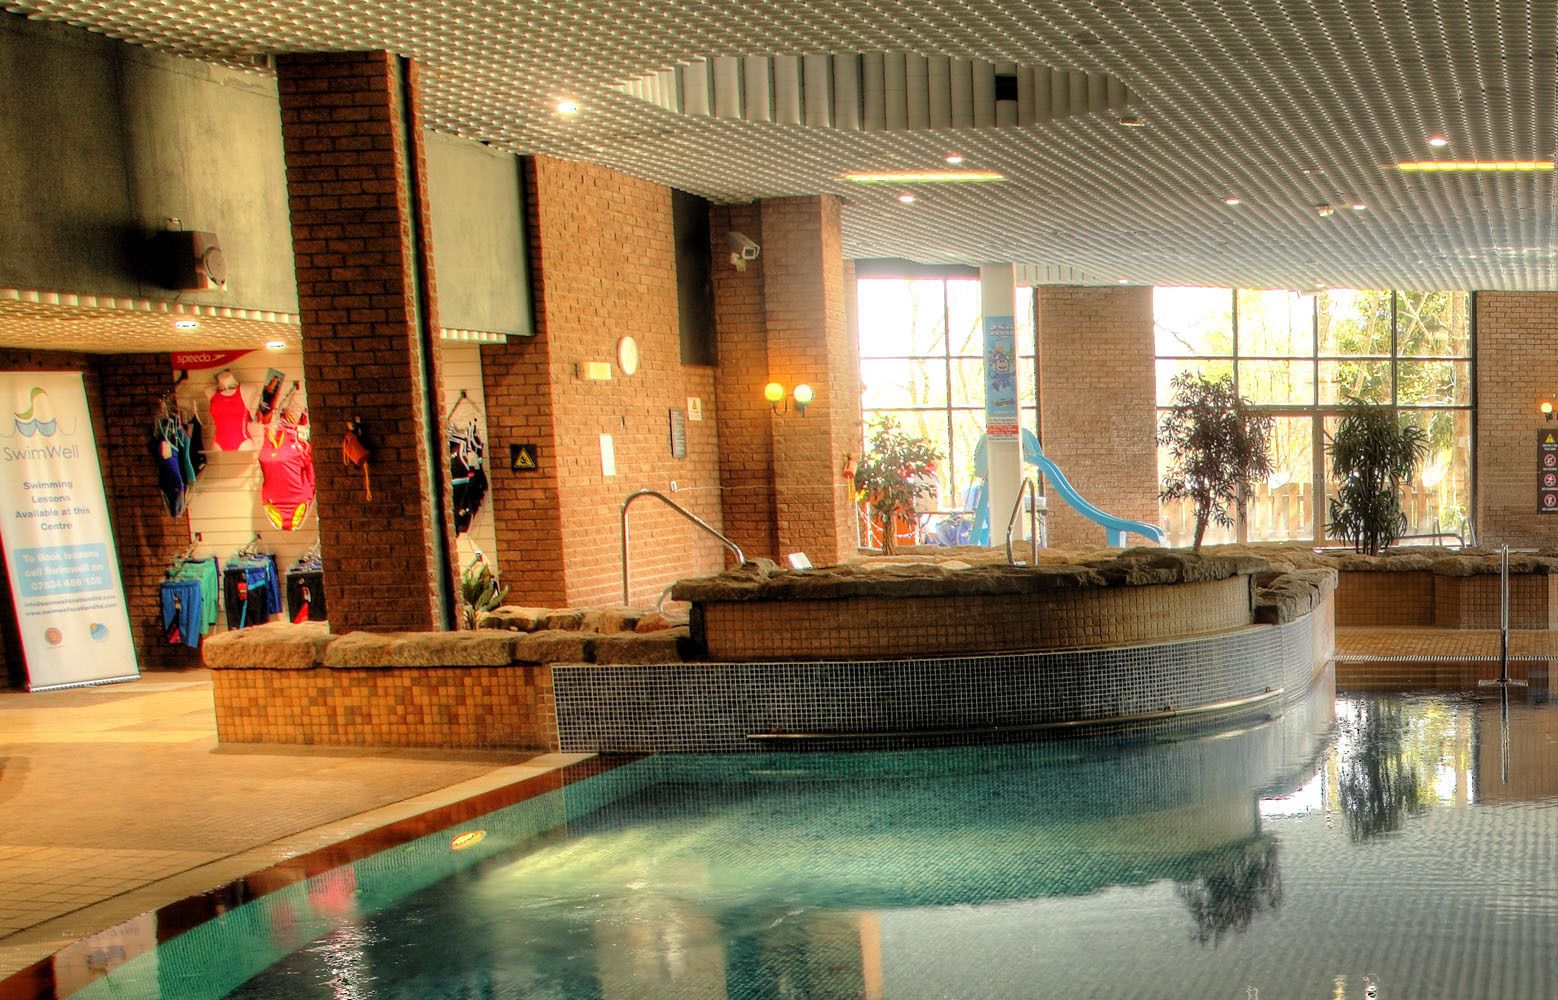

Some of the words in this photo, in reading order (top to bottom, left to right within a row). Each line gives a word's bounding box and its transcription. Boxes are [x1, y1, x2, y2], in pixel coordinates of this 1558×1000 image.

[177, 353, 211, 364] speedo
[3, 444, 80, 461] SwimWell
[23, 480, 73, 490] Swimming
[31, 495, 71, 504] Lessons
[15, 510, 59, 519] Available
[61, 508, 71, 516] at
[73, 506, 91, 515] this
[40, 522, 72, 531] Centre
